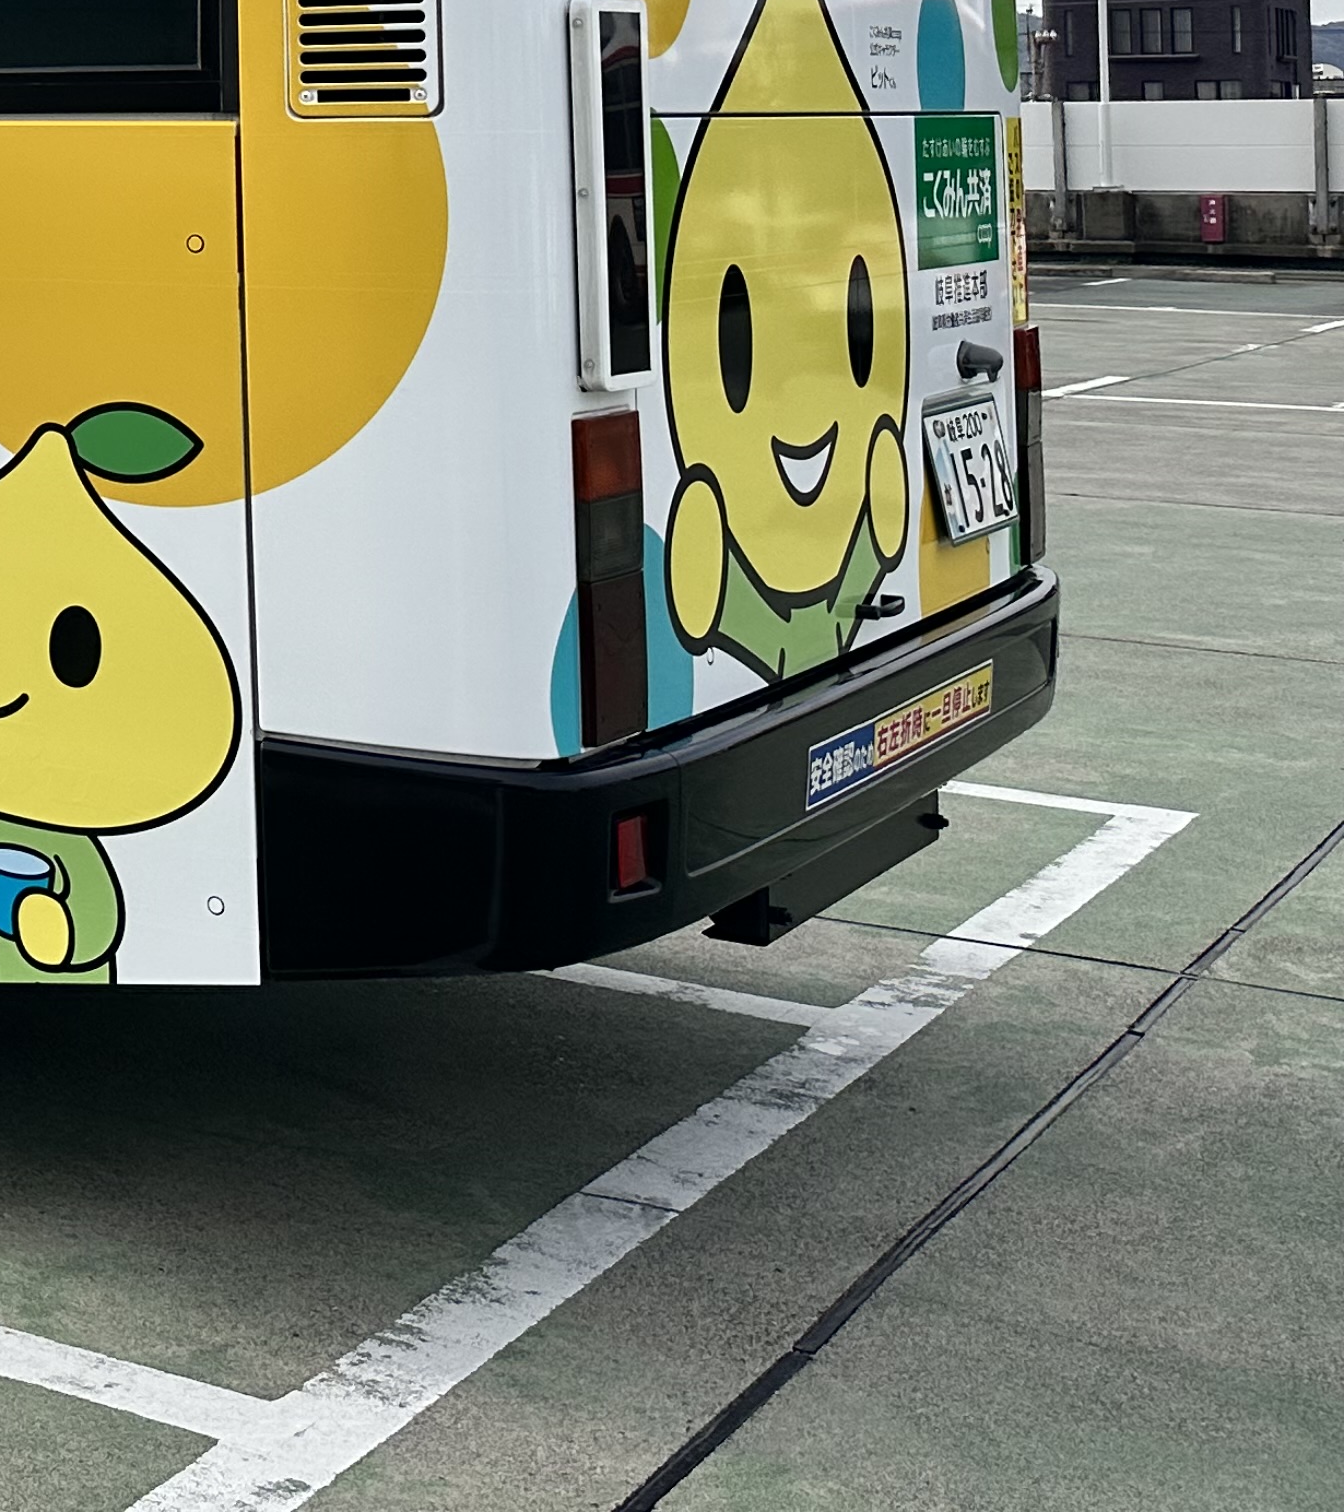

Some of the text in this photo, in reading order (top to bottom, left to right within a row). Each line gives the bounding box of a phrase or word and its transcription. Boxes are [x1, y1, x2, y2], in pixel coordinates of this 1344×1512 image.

[922, 167, 992, 220] こくみん共済
[949, 439, 1014, 528] 15-28
[810, 680, 991, 797] 安全確認のため 右左折時に一旦停止します
